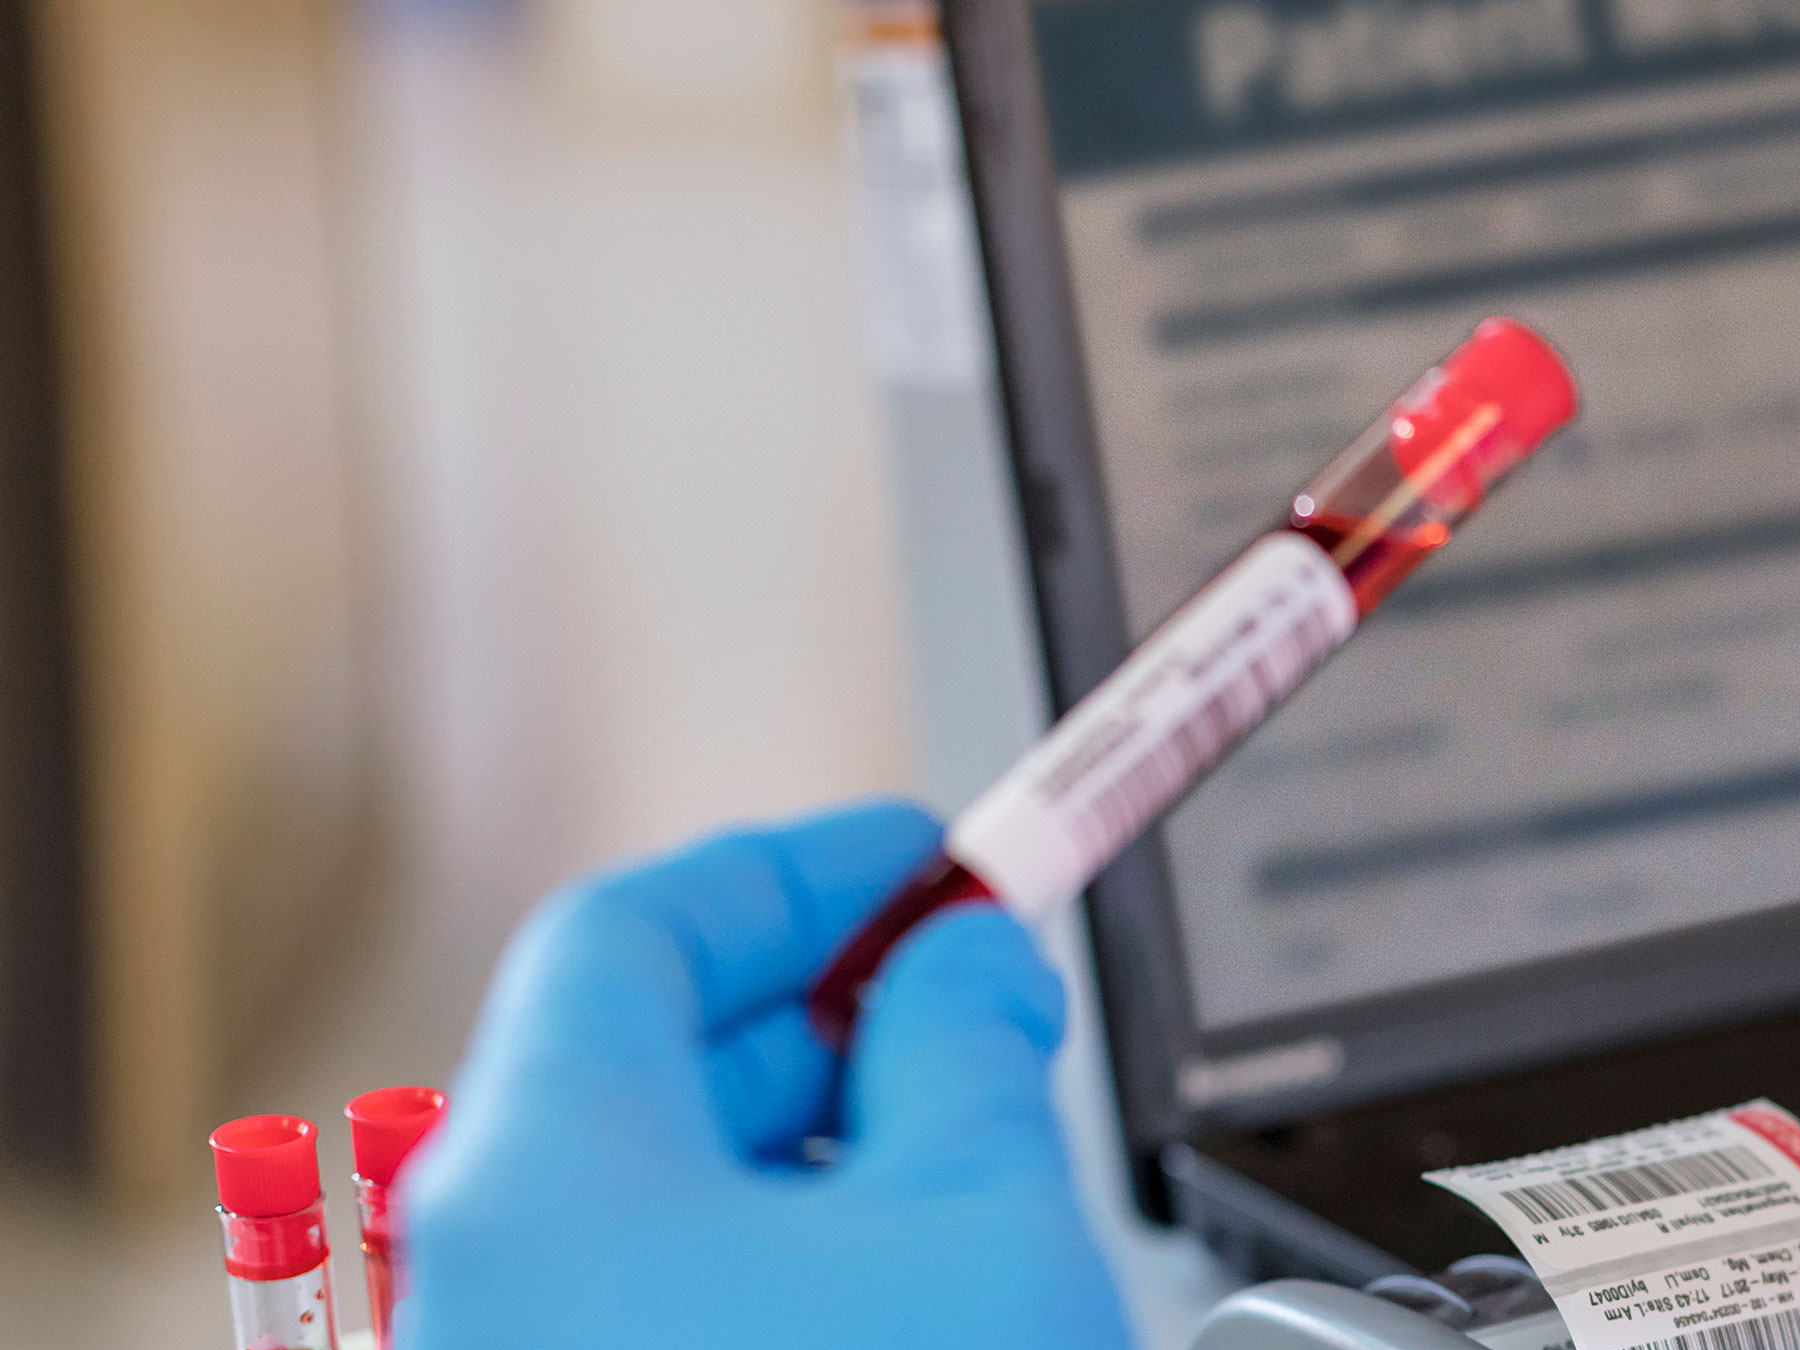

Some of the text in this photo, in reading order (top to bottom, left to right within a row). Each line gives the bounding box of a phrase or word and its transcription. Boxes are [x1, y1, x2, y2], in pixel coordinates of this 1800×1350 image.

[1532, 1232, 1550, 1245] M
[1674, 1288, 1711, 1308] 17:43
[1603, 1304, 1633, 1322] Arm
